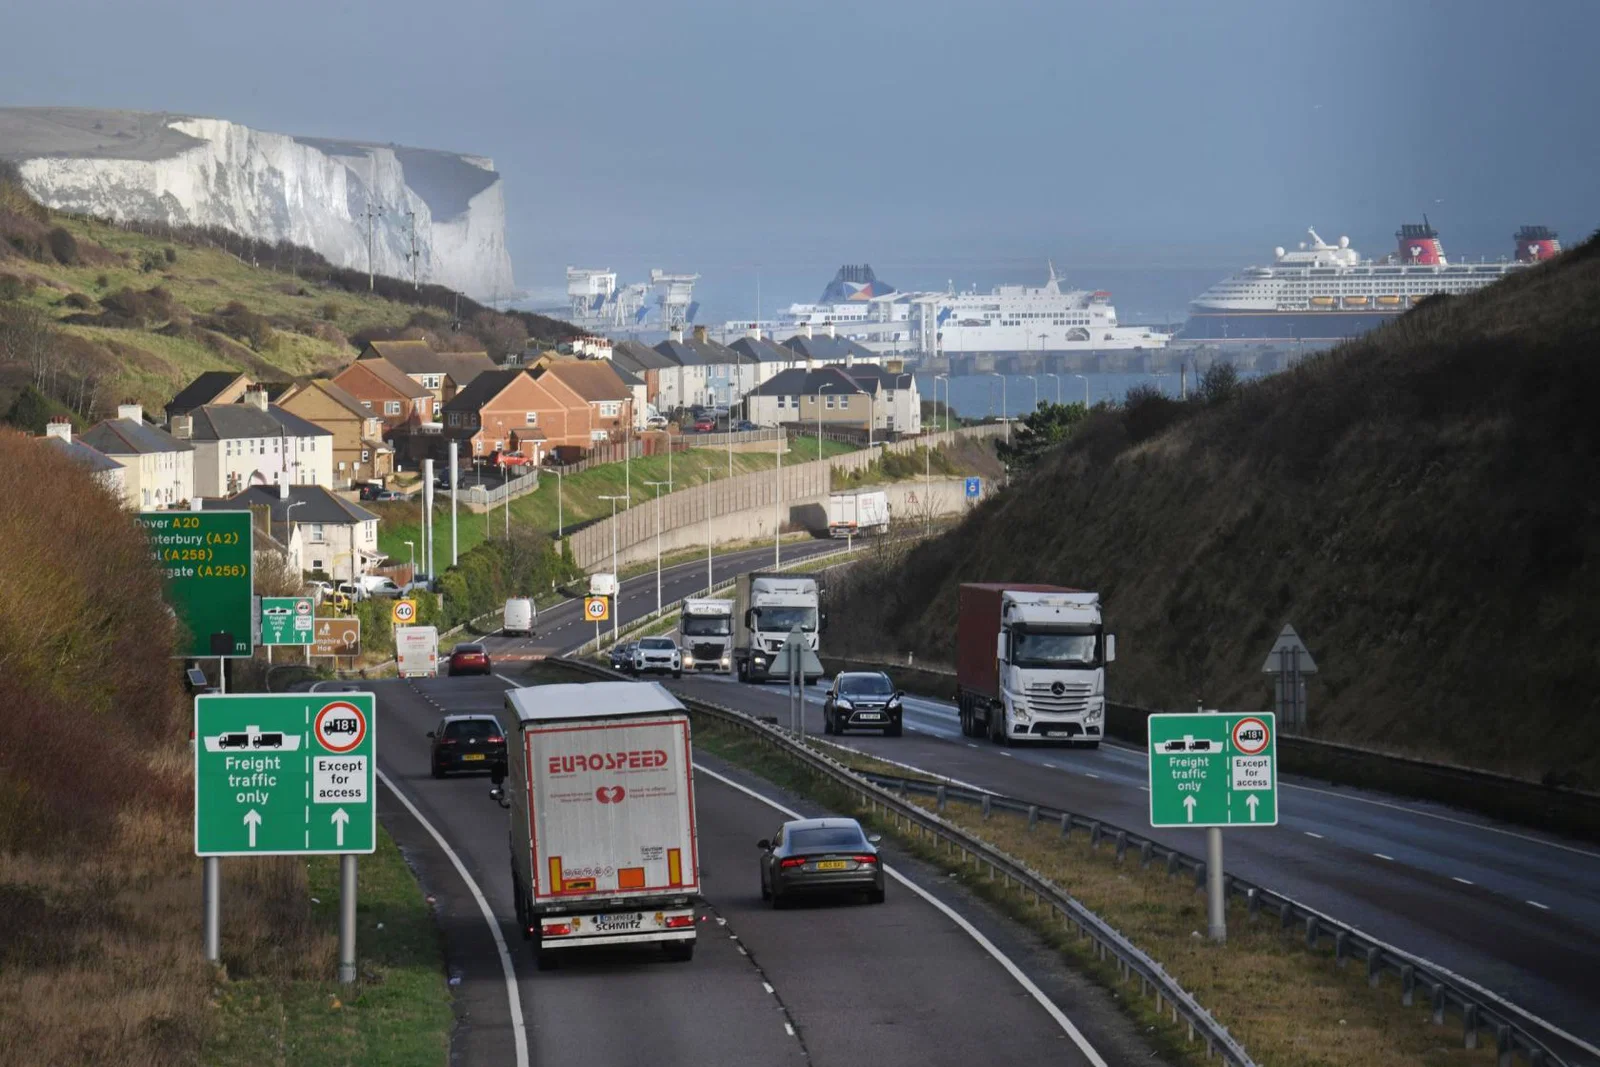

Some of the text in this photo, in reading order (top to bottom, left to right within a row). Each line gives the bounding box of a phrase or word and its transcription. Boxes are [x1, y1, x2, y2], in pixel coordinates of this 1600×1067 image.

[133, 517, 200, 528] Dover A20
[206, 532, 239, 545] (A2)
[164, 548, 214, 562] (A258)
[198, 565, 246, 578] (A256)
[590, 604, 604, 613] 40
[236, 642, 246, 651] m
[226, 756, 280, 772] Freight
[319, 760, 362, 773] Except
[548, 750, 668, 774] EUROSPEED
[1169, 757, 1209, 769] Freight
[1236, 759, 1267, 768] Except
[1172, 769, 1207, 779] traffic
[1245, 768, 1258, 776] for
[228, 774, 277, 787] traffic
[331, 773, 349, 784] for
[1178, 781, 1202, 792] only
[236, 790, 269, 805] only
[319, 788, 362, 798] access
[596, 921, 641, 932] SCHMITZ
